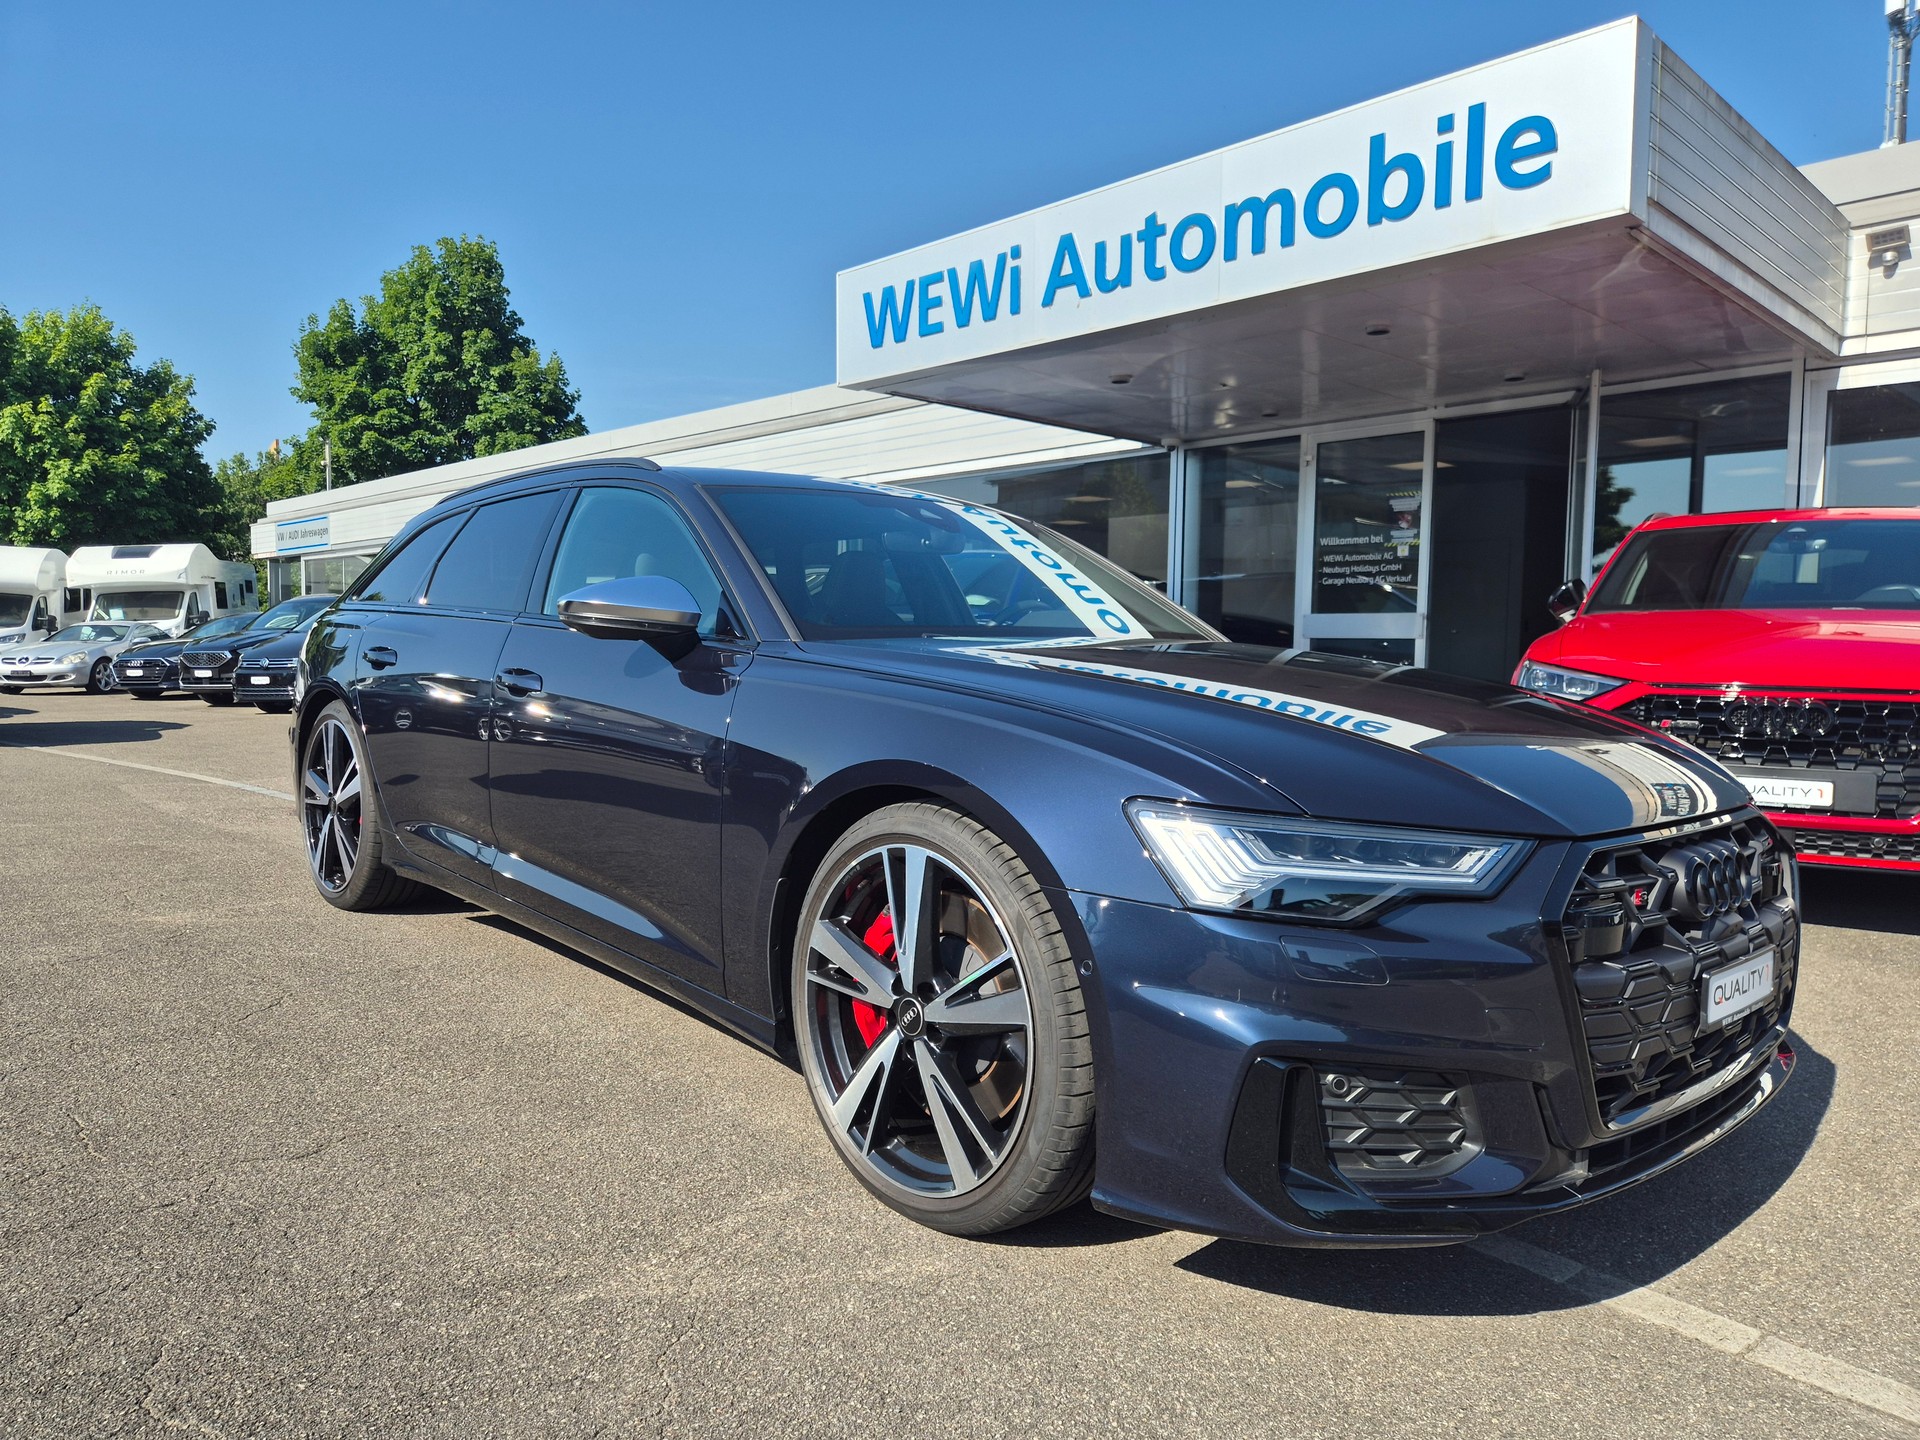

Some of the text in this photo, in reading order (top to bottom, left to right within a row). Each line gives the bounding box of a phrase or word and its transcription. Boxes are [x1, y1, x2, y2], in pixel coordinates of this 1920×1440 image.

[863, 101, 1558, 349] WEWi Automobile
[276, 532, 285, 541] VW
[288, 529, 300, 541] AUDI
[300, 527, 329, 539] Jahreswagen
[1320, 536, 1369, 546] Willkommen
[1370, 533, 1384, 544] bei
[1323, 551, 1394, 563] WEWi Automobile AG
[1322, 563, 1402, 575] Neuburg Holidays GmbH
[1322, 577, 1345, 587] Garage
[1374, 575, 1385, 583] AG
[1385, 574, 1412, 583] Verkauf
[1713, 965, 1765, 1006] QUALITY
